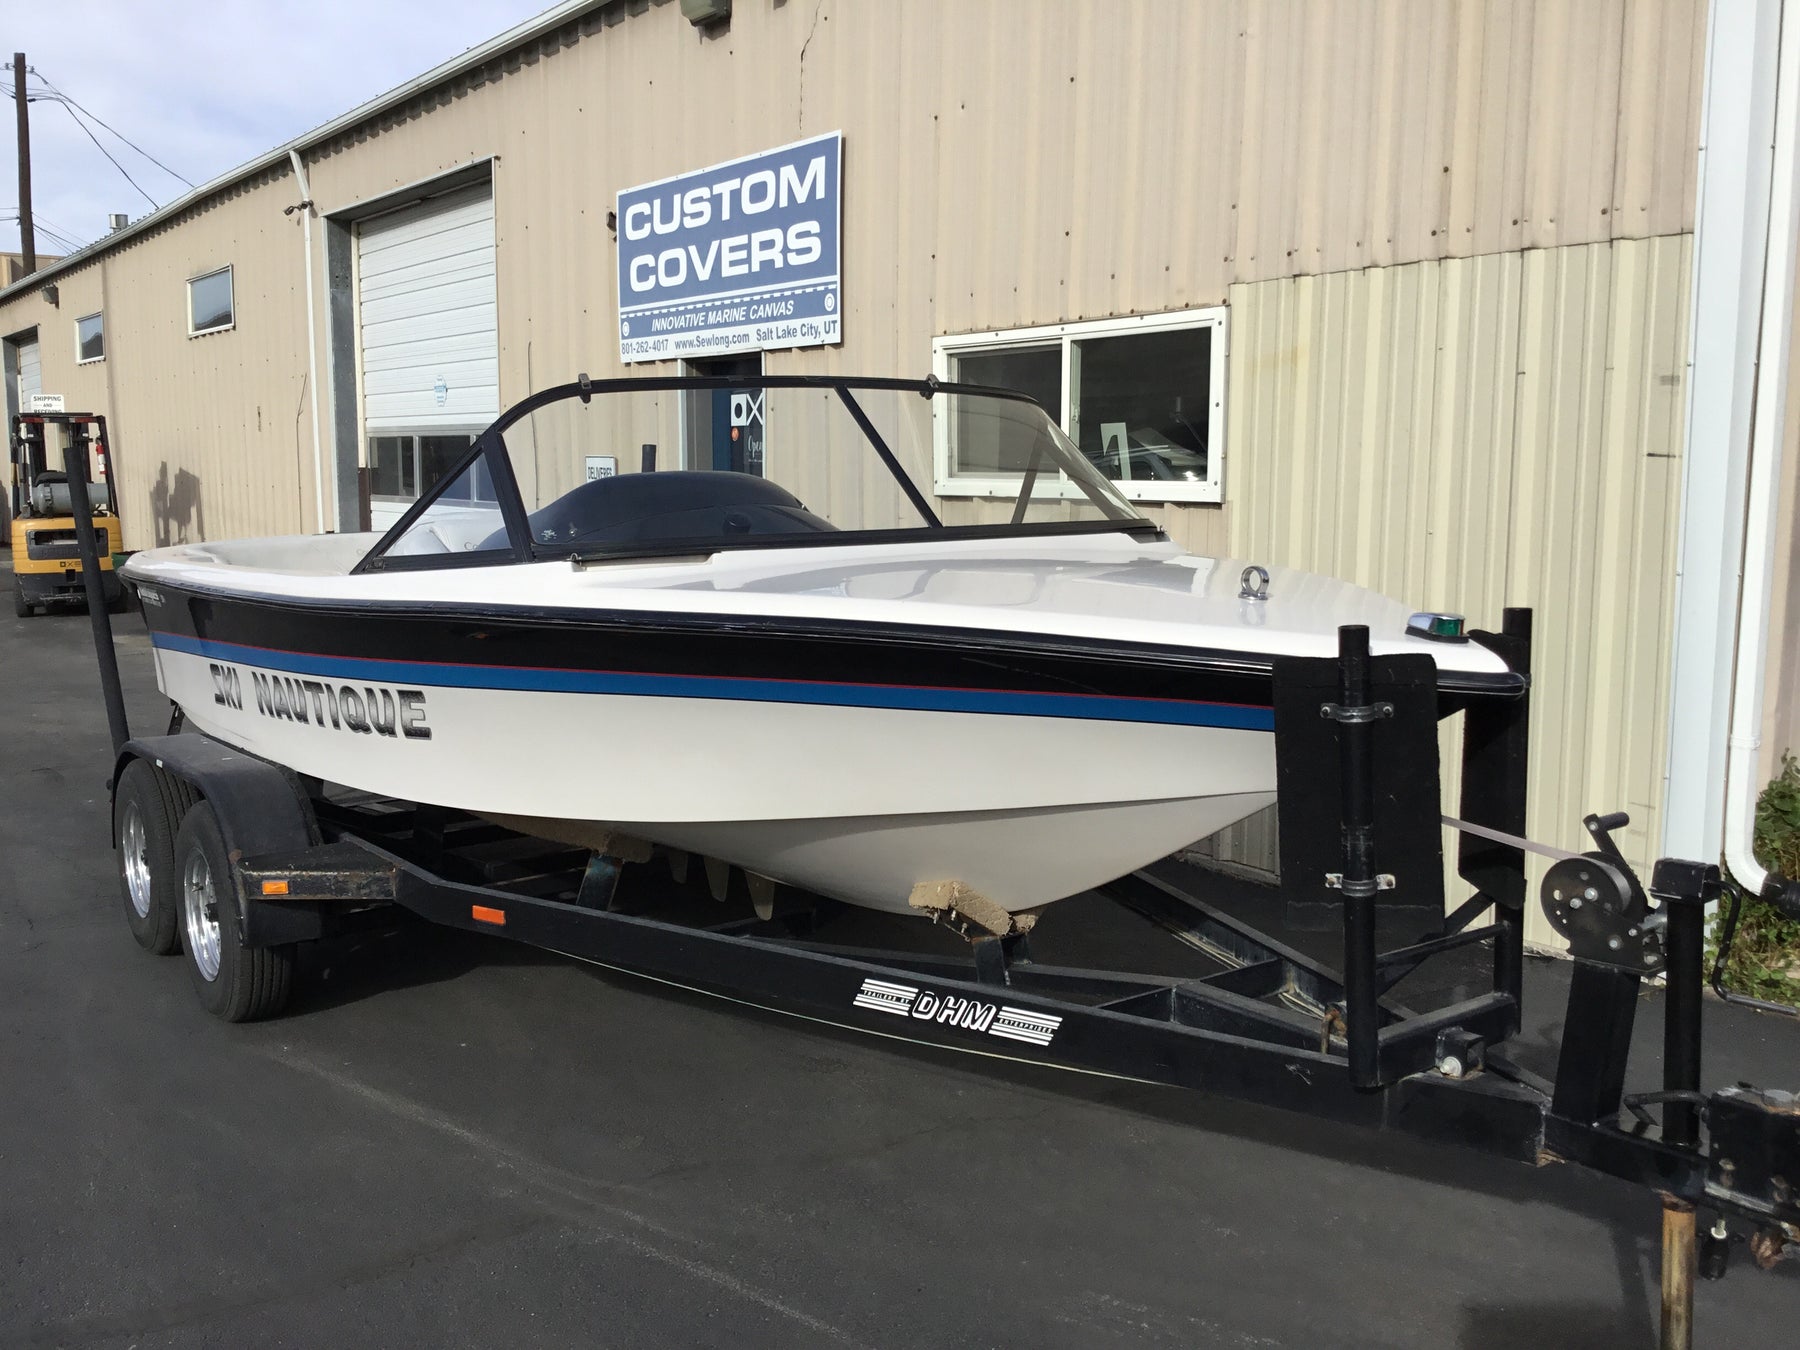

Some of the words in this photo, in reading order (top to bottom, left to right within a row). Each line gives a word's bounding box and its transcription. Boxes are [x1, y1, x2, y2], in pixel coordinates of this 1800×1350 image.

[625, 155, 826, 241] CUSTOM
[630, 220, 822, 292] COVERS
[621, 339, 669, 355] 801-262-4017
[674, 333, 750, 350] www.Sewlong.com
[756, 326, 774, 342] Salt
[776, 325, 798, 340] Lake
[800, 322, 821, 340] City,
[824, 319, 838, 334] UT
[651, 312, 706, 332] INNOVATIVE
[707, 306, 748, 325] MARINE
[749, 300, 794, 320] CANVAS
[209, 663, 243, 711] SKI
[251, 671, 432, 740] NAUTIQUE
[863, 989, 897, 1002] TRAILERS
[911, 991, 997, 1032] DHM
[998, 1018, 1052, 1034] ENTERPRISES
